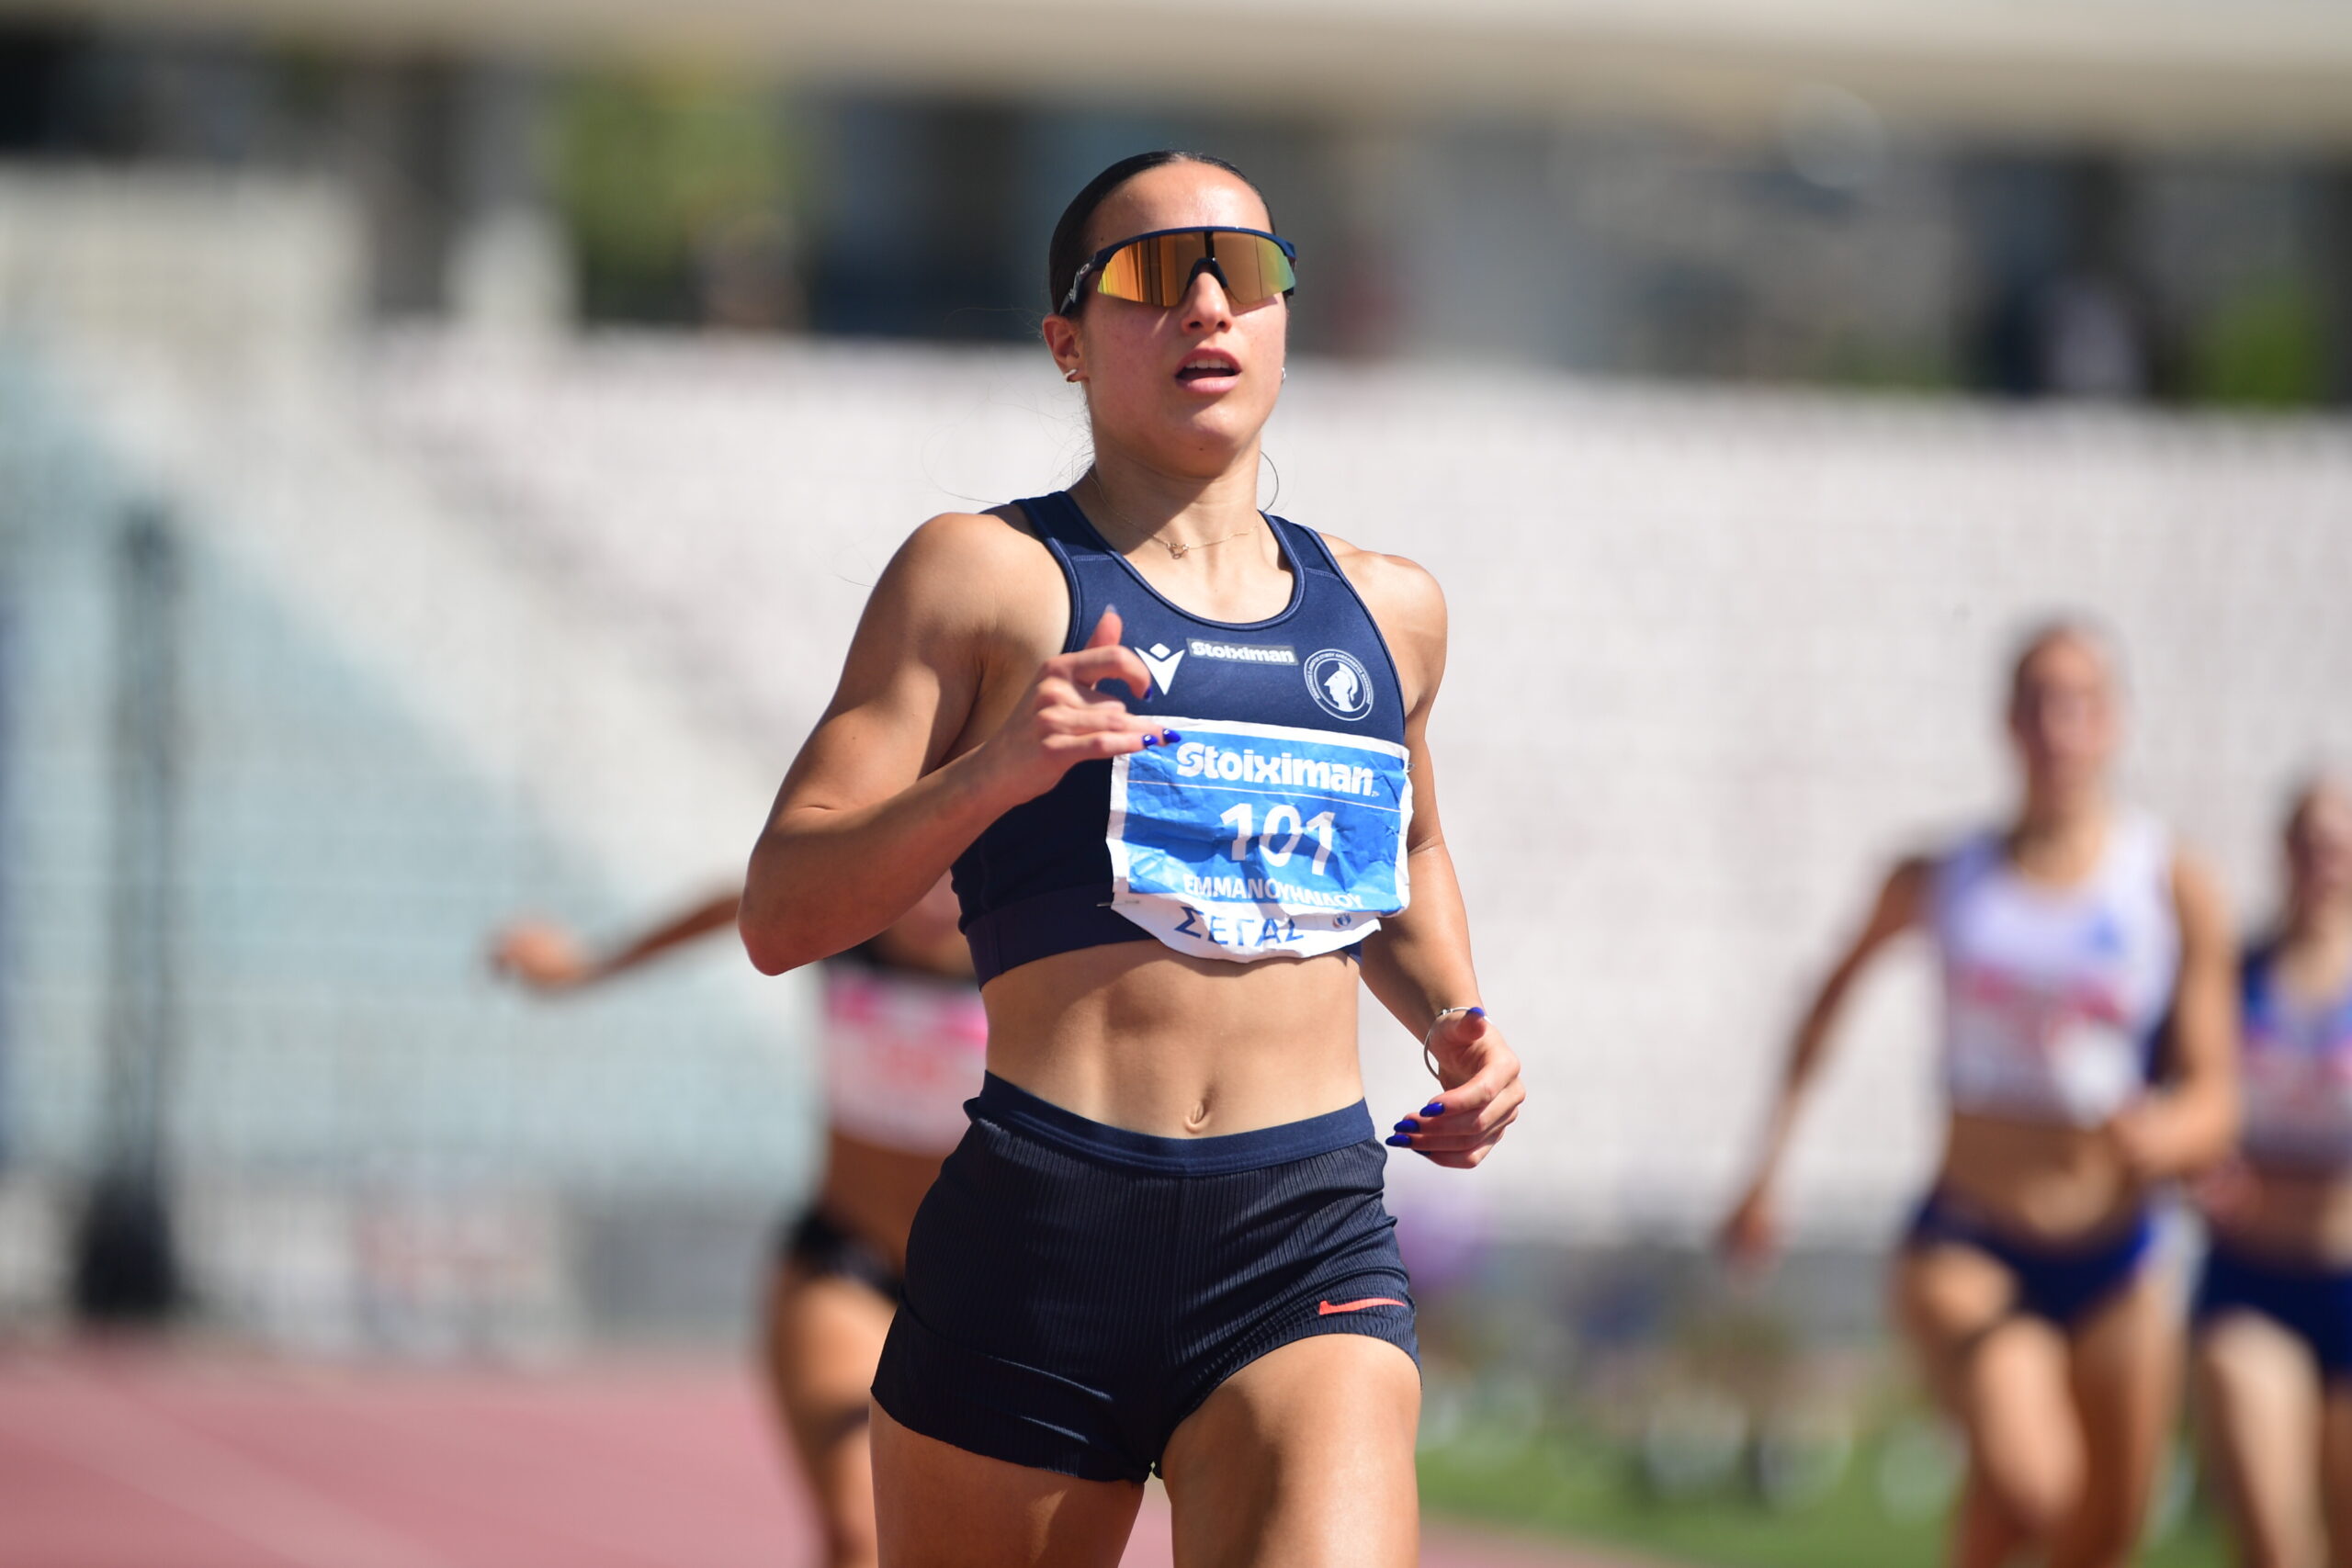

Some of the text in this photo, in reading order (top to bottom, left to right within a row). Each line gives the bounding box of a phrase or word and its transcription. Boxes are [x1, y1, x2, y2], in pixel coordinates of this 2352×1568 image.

[1191, 641, 1295, 663] Stoiximan
[1176, 741, 1374, 797] Stoiximan
[1220, 803, 1336, 876] 101
[1174, 905, 1305, 947] ΣΕΓΑΣ
